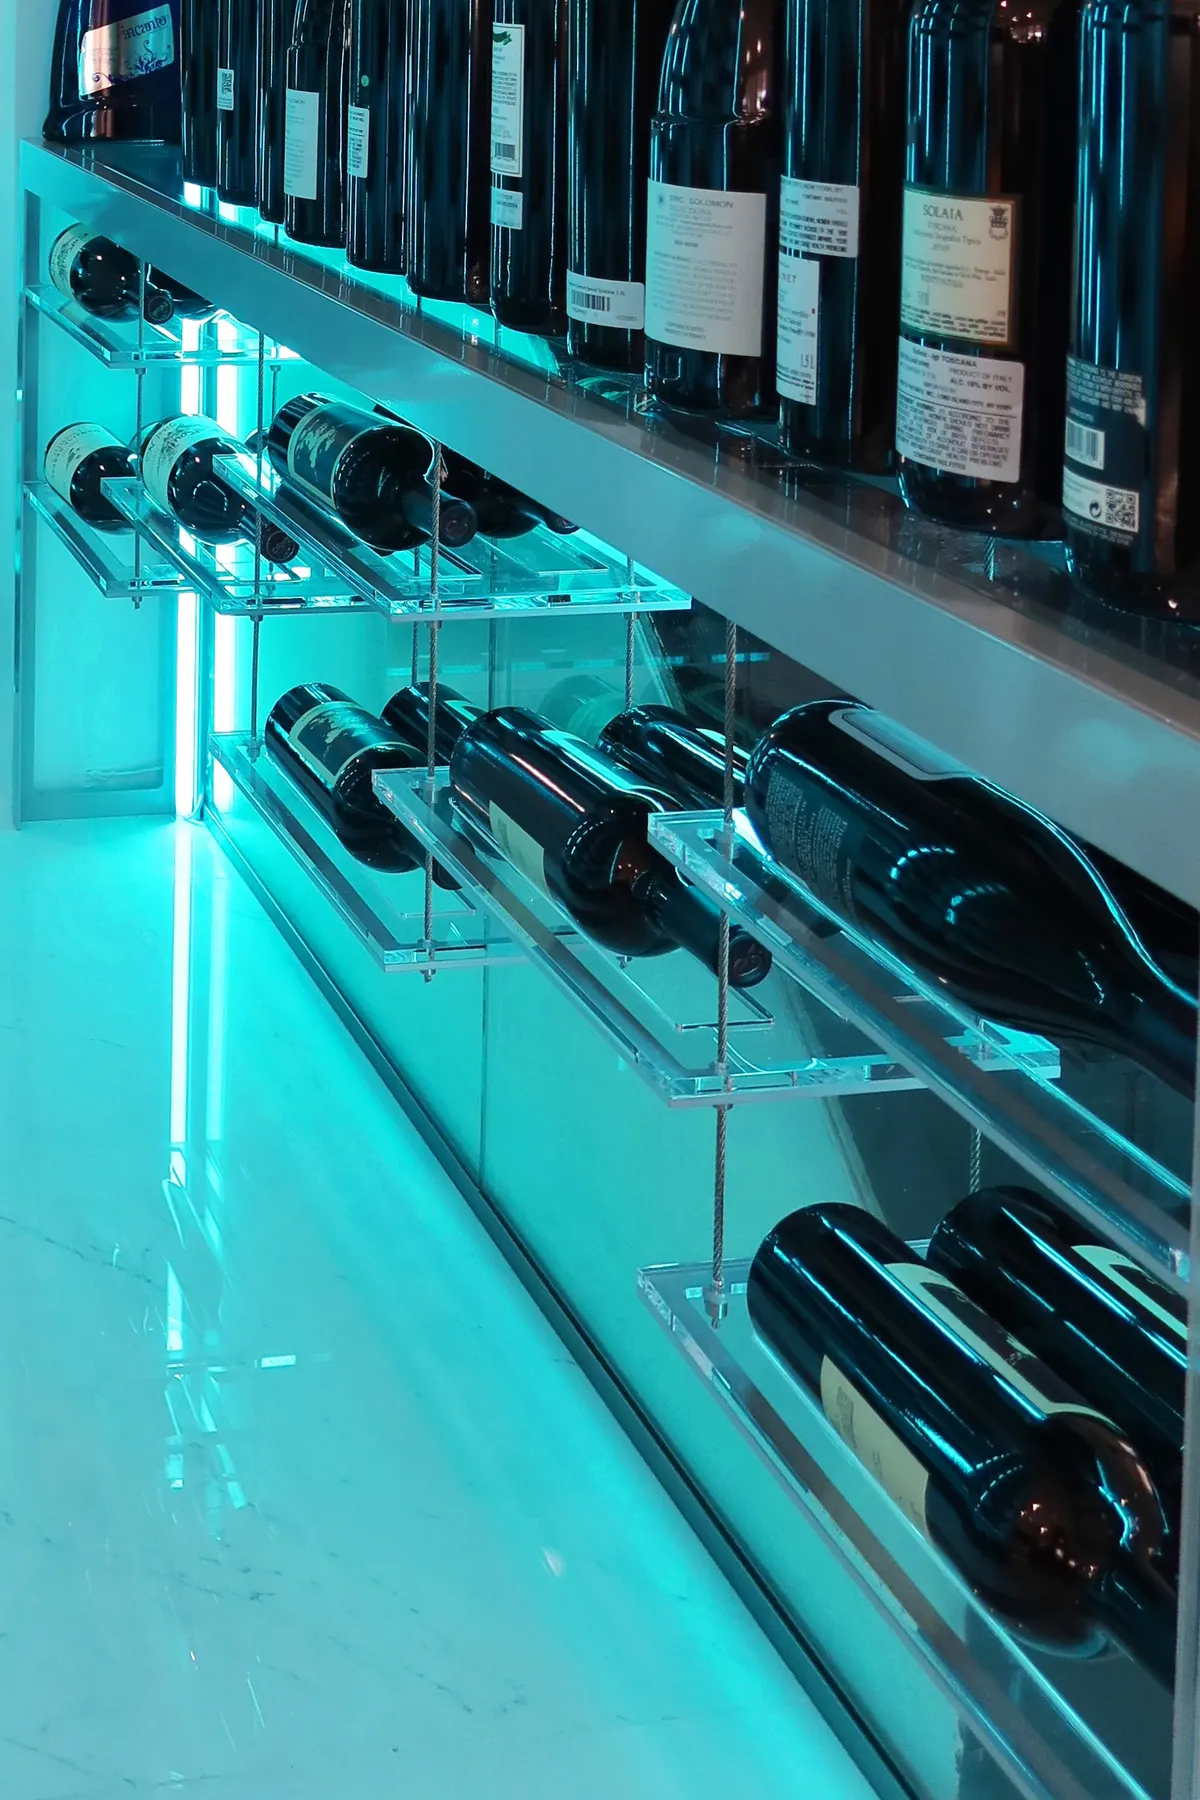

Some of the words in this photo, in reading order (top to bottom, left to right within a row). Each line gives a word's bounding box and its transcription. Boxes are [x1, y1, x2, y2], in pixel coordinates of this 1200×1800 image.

[121, 15, 169, 40] incanto
[688, 197, 734, 209] SOLOMON
[923, 204, 963, 221] SOLAIA
[942, 355, 977, 368] TOSCANA
